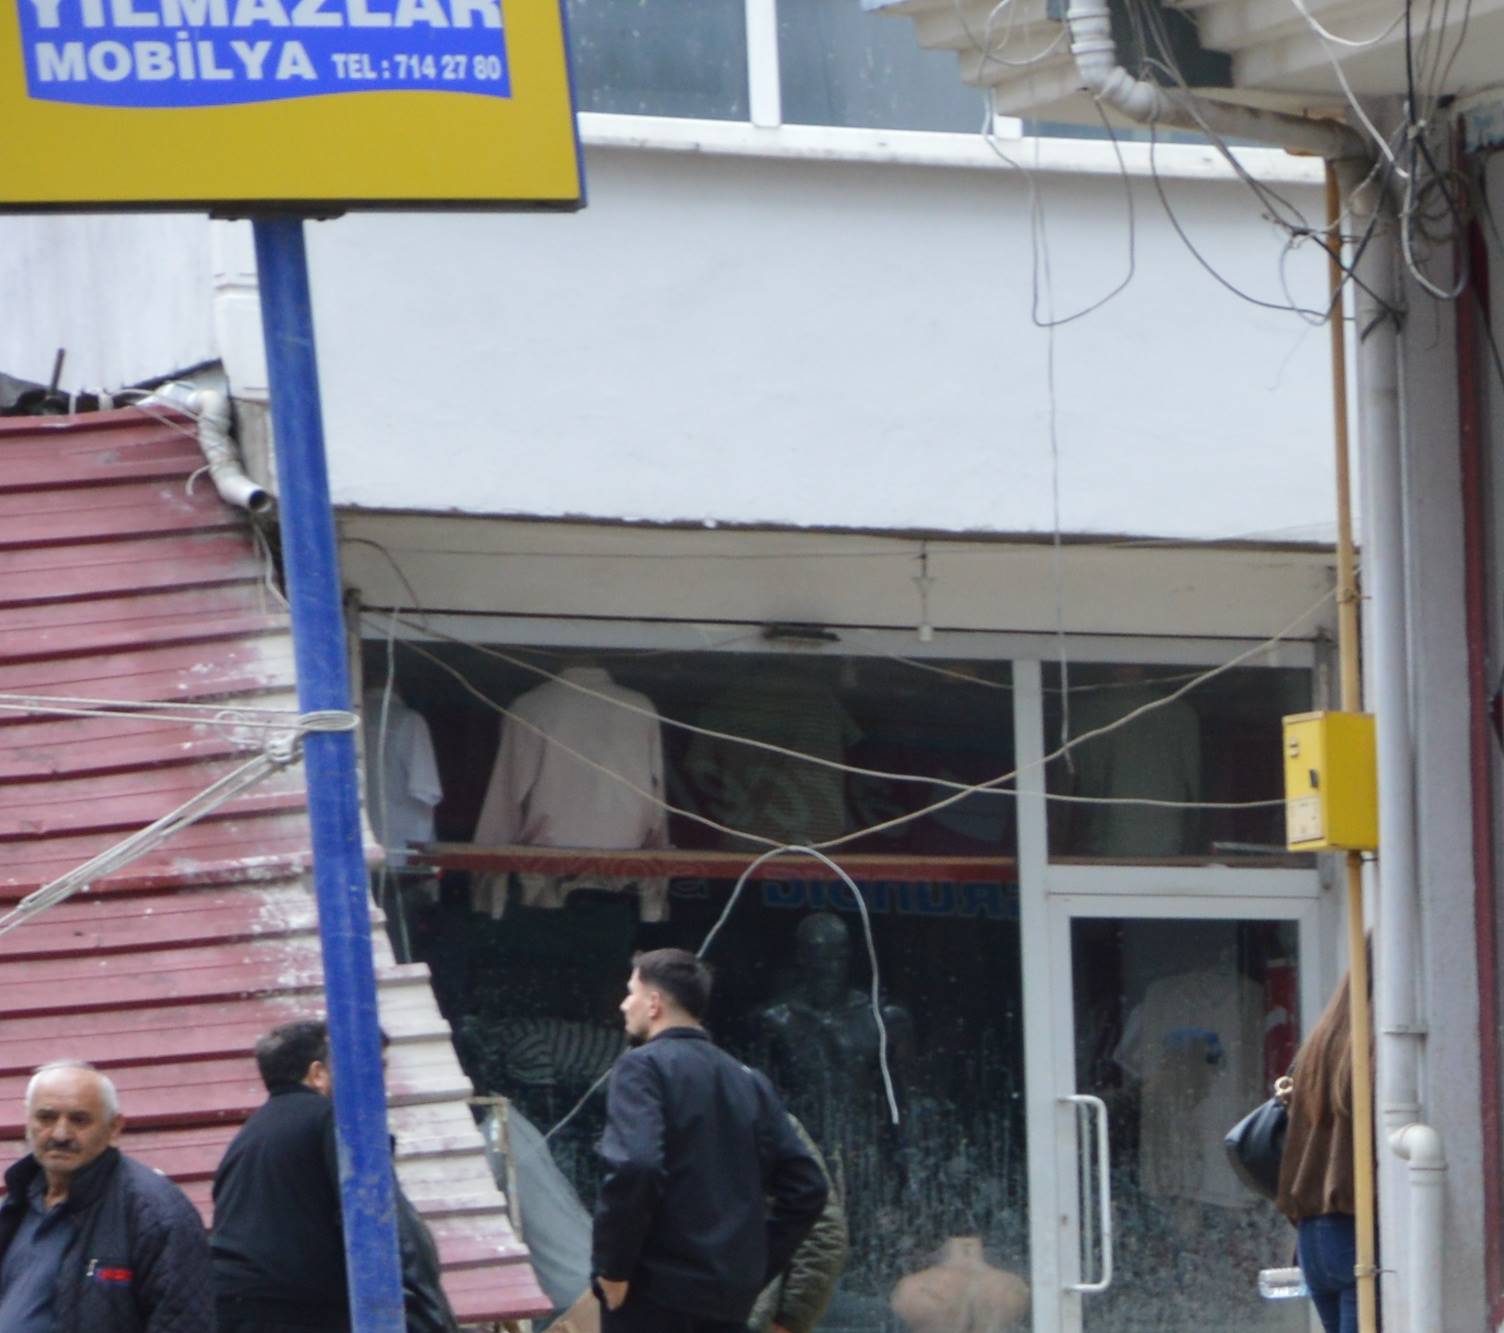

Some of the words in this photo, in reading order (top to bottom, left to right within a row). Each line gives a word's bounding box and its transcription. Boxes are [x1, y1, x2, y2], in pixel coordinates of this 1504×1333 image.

[36, 32, 317, 82] MOBİLYA
[396, 54, 436, 79] 714
[441, 55, 467, 80] 27
[473, 56, 501, 80] 80
